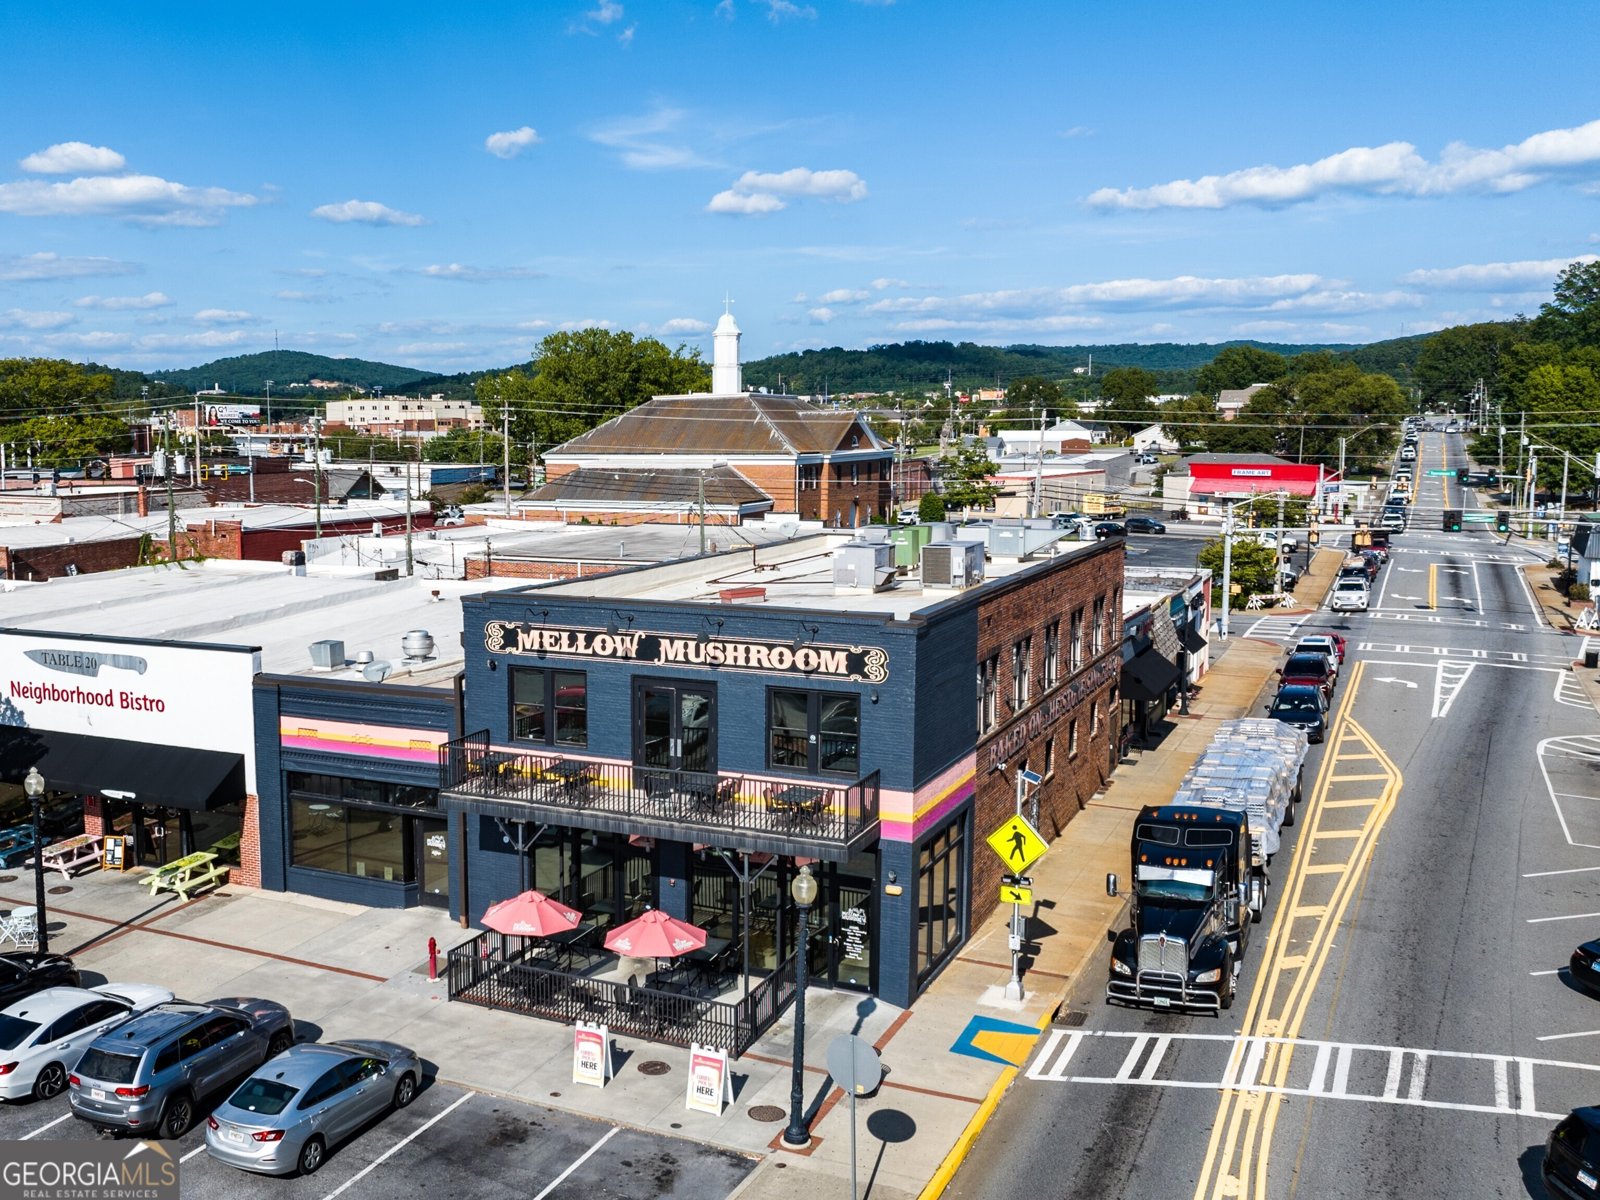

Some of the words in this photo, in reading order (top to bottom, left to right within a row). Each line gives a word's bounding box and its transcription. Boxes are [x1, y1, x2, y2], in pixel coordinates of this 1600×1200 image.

[41, 652, 82, 669] TABLE
[85, 656, 97, 670] 20
[515, 628, 645, 658] MELLOW
[654, 638, 848, 675] MUSHROOM
[10, 680, 114, 707] Neighborhood
[120, 691, 165, 713] Bistro
[1028, 710, 1042, 739] ON
[580, 1060, 598, 1071] HERE
[696, 1085, 714, 1097] HERE
